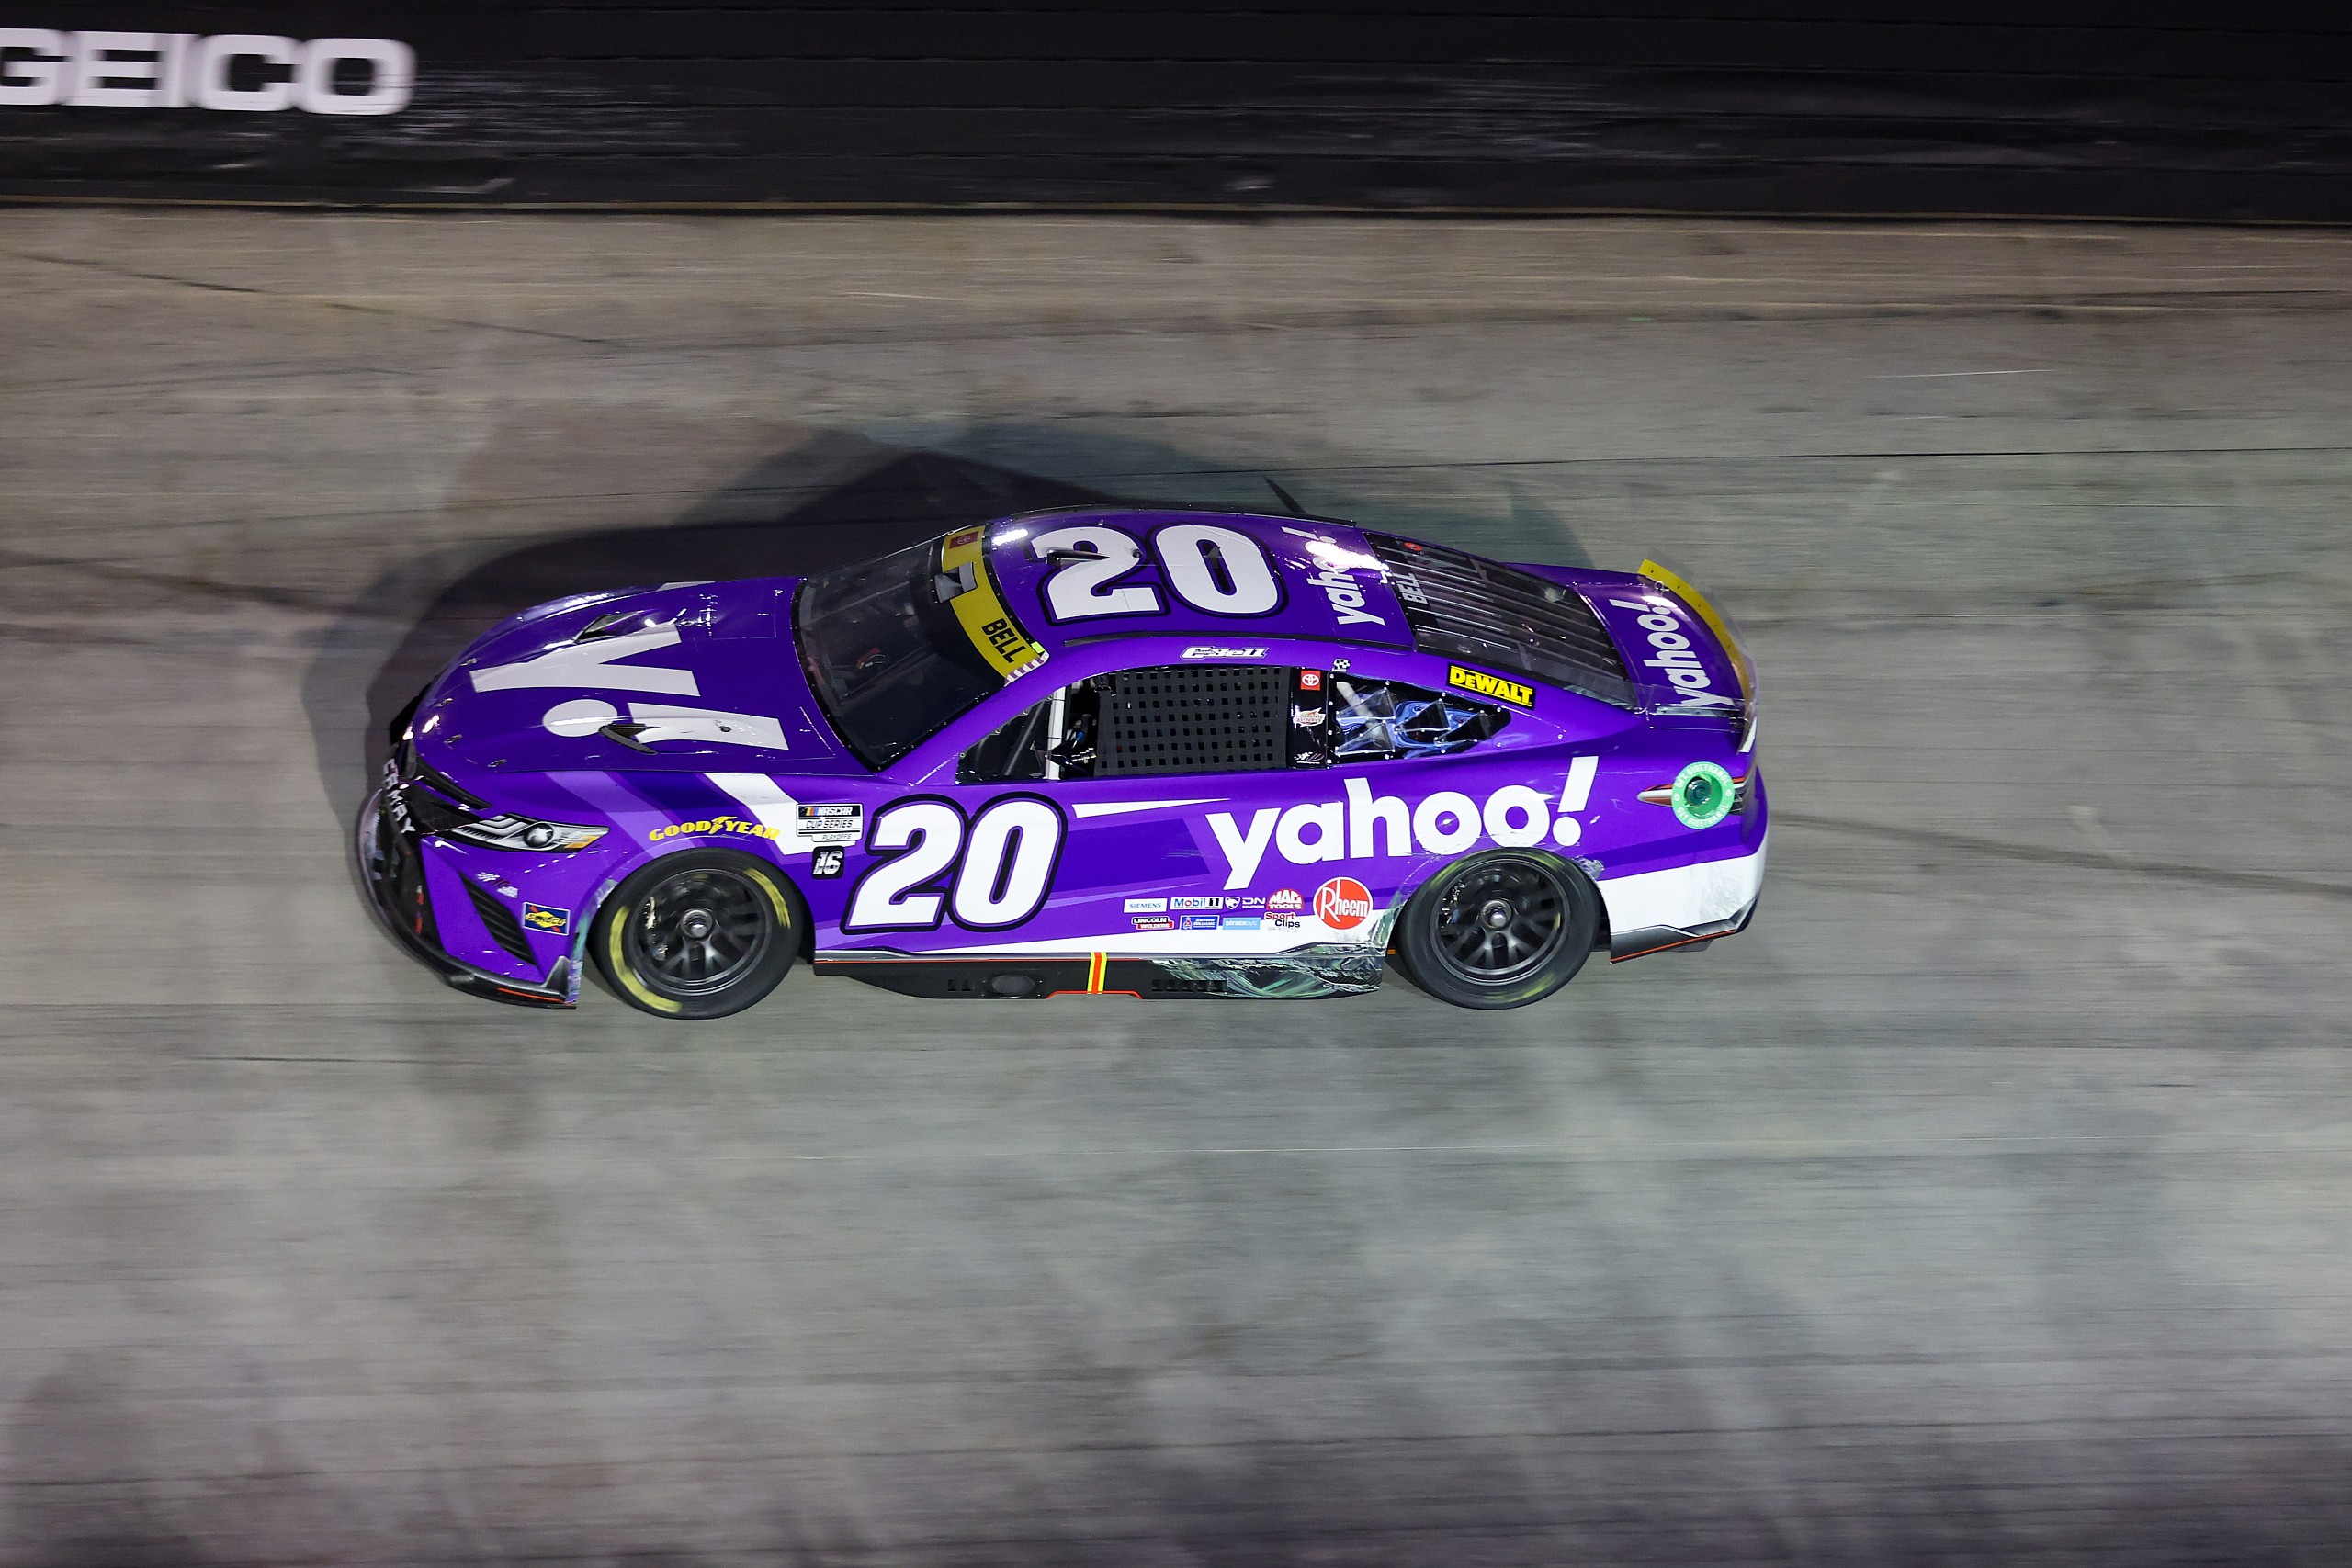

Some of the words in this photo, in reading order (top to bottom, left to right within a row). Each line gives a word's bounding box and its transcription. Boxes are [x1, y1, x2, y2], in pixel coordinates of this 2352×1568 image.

[0, 28, 418, 116] GEICO
[1030, 523, 1282, 621] 20
[1281, 526, 1385, 626] yaho!
[1392, 573, 1428, 604] BELL
[981, 618, 1026, 663] BELL
[1609, 599, 1735, 706] yahoo!
[649, 817, 779, 840] GOODYEAR
[806, 820, 822, 829] CUP
[823, 819, 854, 829] SERIES
[818, 807, 853, 816] NASCAR
[1205, 756, 1599, 890] yahoo!
[843, 795, 1064, 931] 20
[1173, 898, 1206, 907] Mobil
[1265, 912, 1295, 921] Sport
[1320, 879, 1369, 923] Rheem
[1274, 919, 1301, 928] Clips
